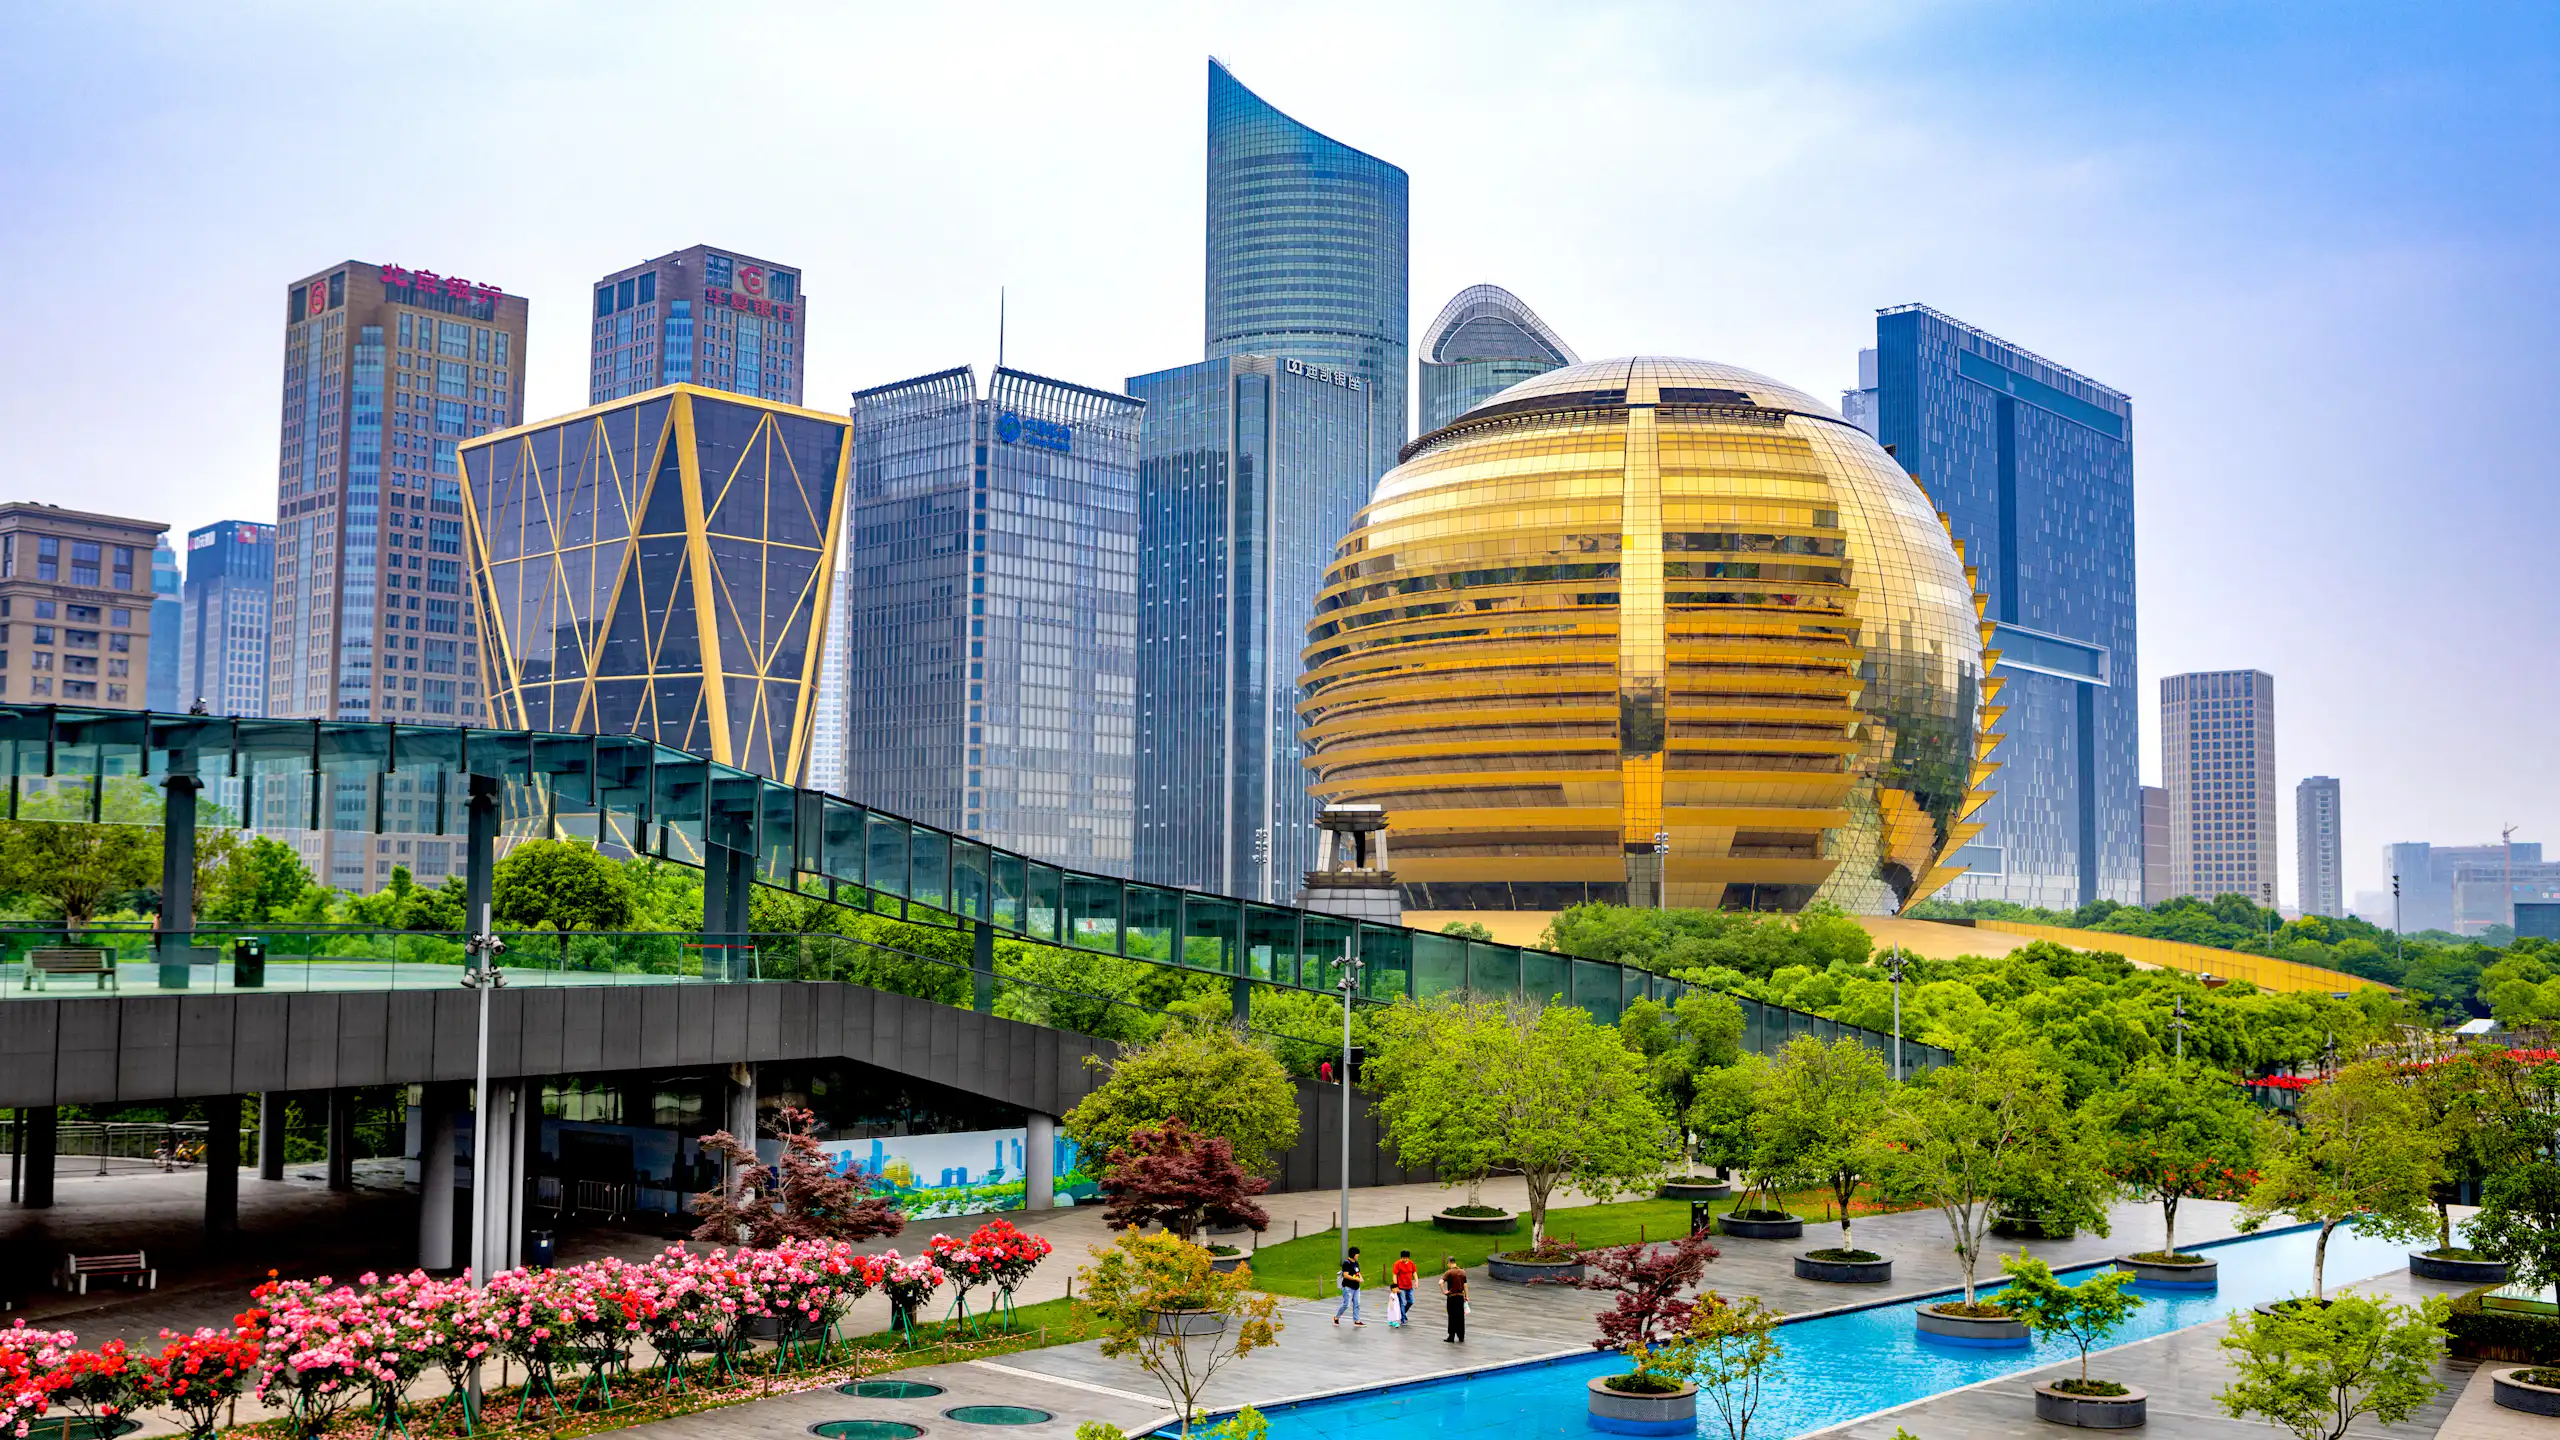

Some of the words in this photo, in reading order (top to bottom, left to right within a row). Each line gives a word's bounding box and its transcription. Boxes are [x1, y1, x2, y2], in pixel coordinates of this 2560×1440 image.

[380, 263, 503, 309] 北京银行
[705, 287, 796, 322] 华夏银行
[1305, 364, 1361, 391] 迪凯银座
